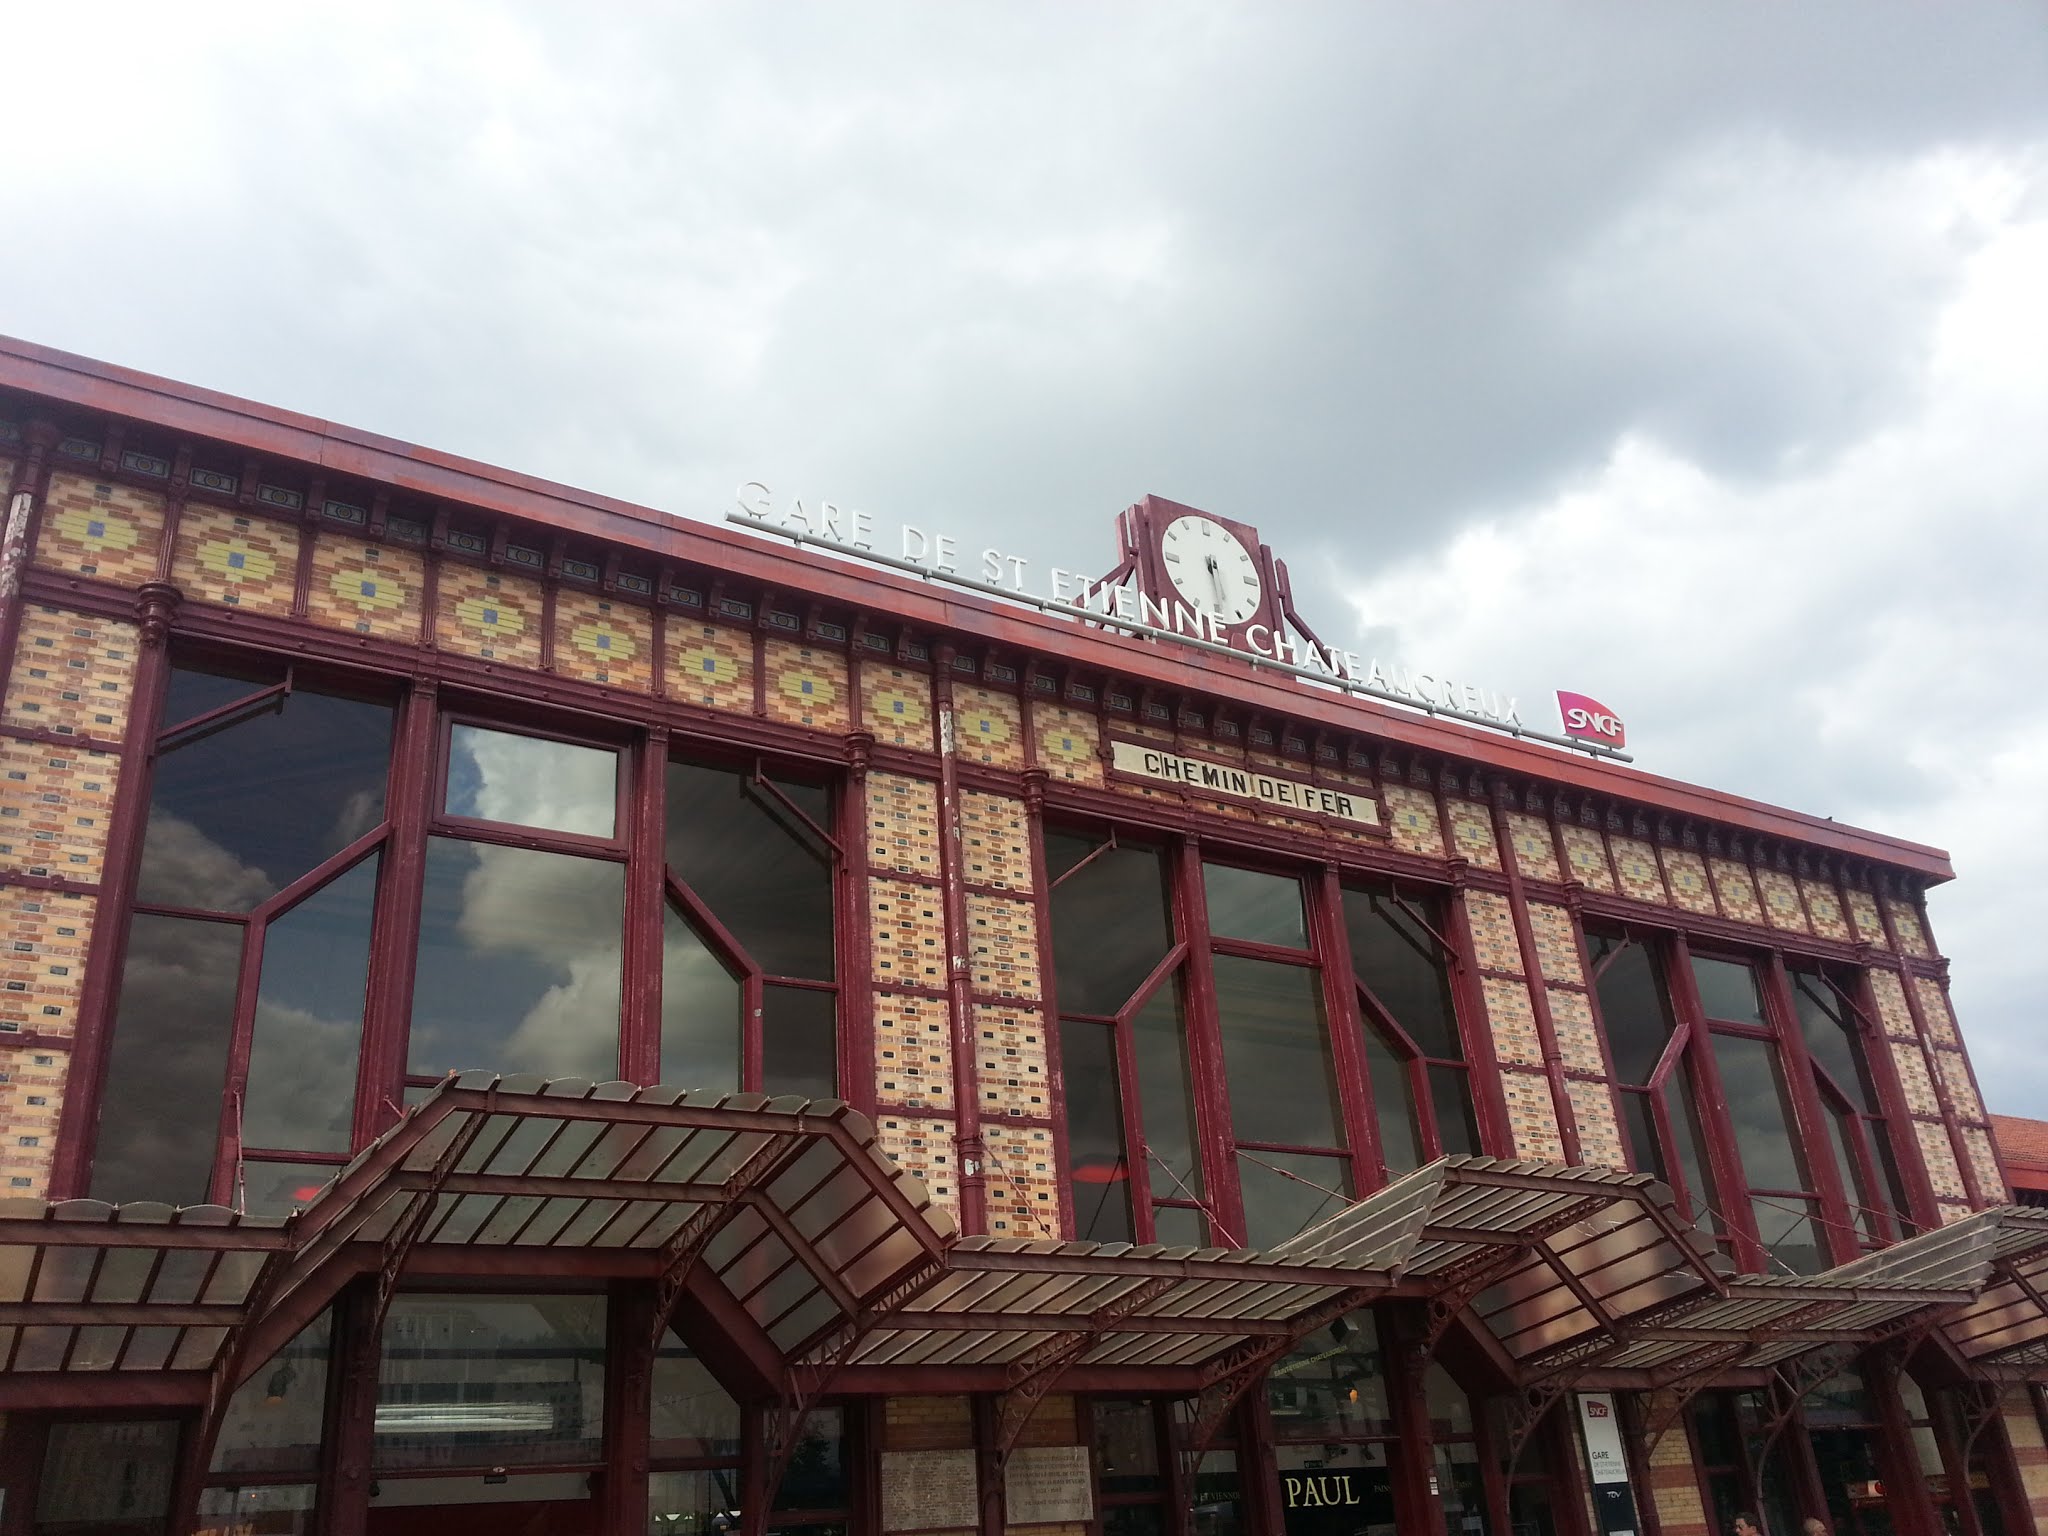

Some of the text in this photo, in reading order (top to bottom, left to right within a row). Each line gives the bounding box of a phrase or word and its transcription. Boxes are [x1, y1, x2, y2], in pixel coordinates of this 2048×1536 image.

[737, 481, 873, 549] GARE
[902, 524, 958, 573] DE
[982, 549, 1027, 591] ST
[1051, 568, 1229, 645] ETIENNE
[1567, 708, 1623, 737] SNCF
[1144, 752, 1354, 817] CHEMIN DE FER
[1589, 1407, 1607, 1417] SNCF
[1592, 1451, 1609, 1460] GARE
[1285, 1475, 1361, 1508] PAUL
